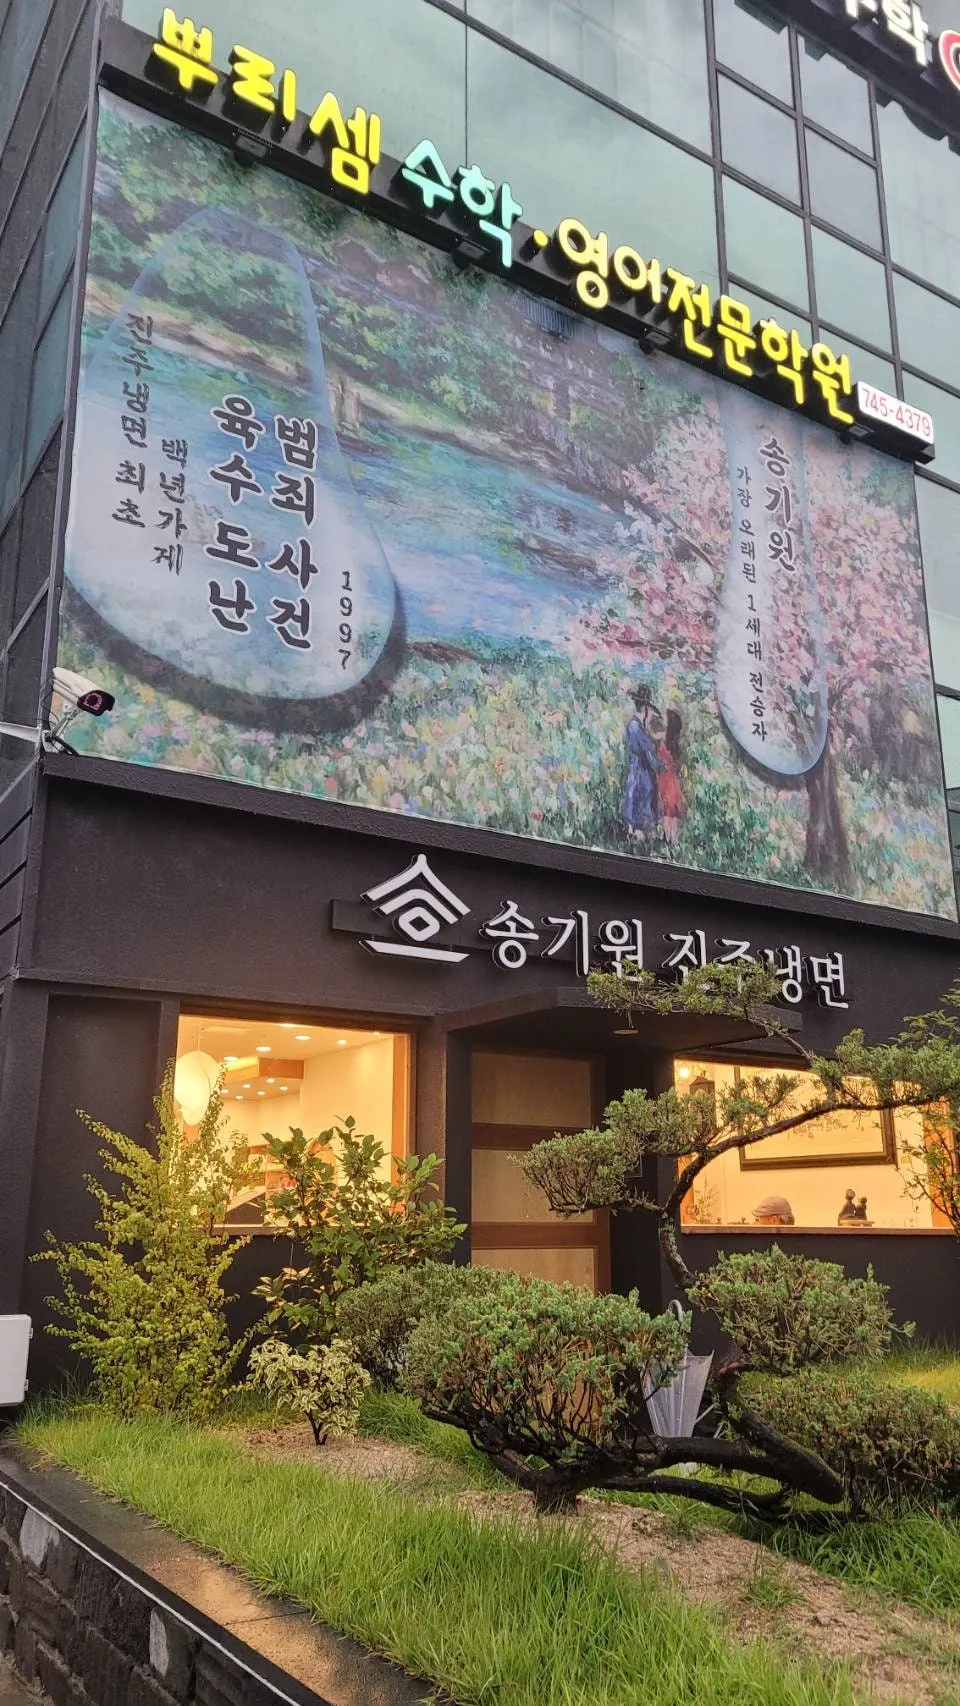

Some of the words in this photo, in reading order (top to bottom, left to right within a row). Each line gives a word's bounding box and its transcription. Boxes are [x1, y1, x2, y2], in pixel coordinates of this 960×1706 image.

[121, 312, 154, 449] 진주냉면
[862, 387, 932, 437] 745-4379
[111, 459, 146, 529] 최초
[208, 395, 264, 503] 육수
[270, 416, 317, 527] 범죄
[735, 465, 753, 509] 가장
[758, 435, 797, 573] 송기원
[204, 520, 260, 634] 도난
[266, 537, 320, 650] 사건
[738, 518, 757, 585] 오래된
[337, 570, 354, 671] 1997
[745, 592, 762, 663] 1세대
[748, 671, 768, 743] 전승자
[484, 899, 644, 982] 송기원
